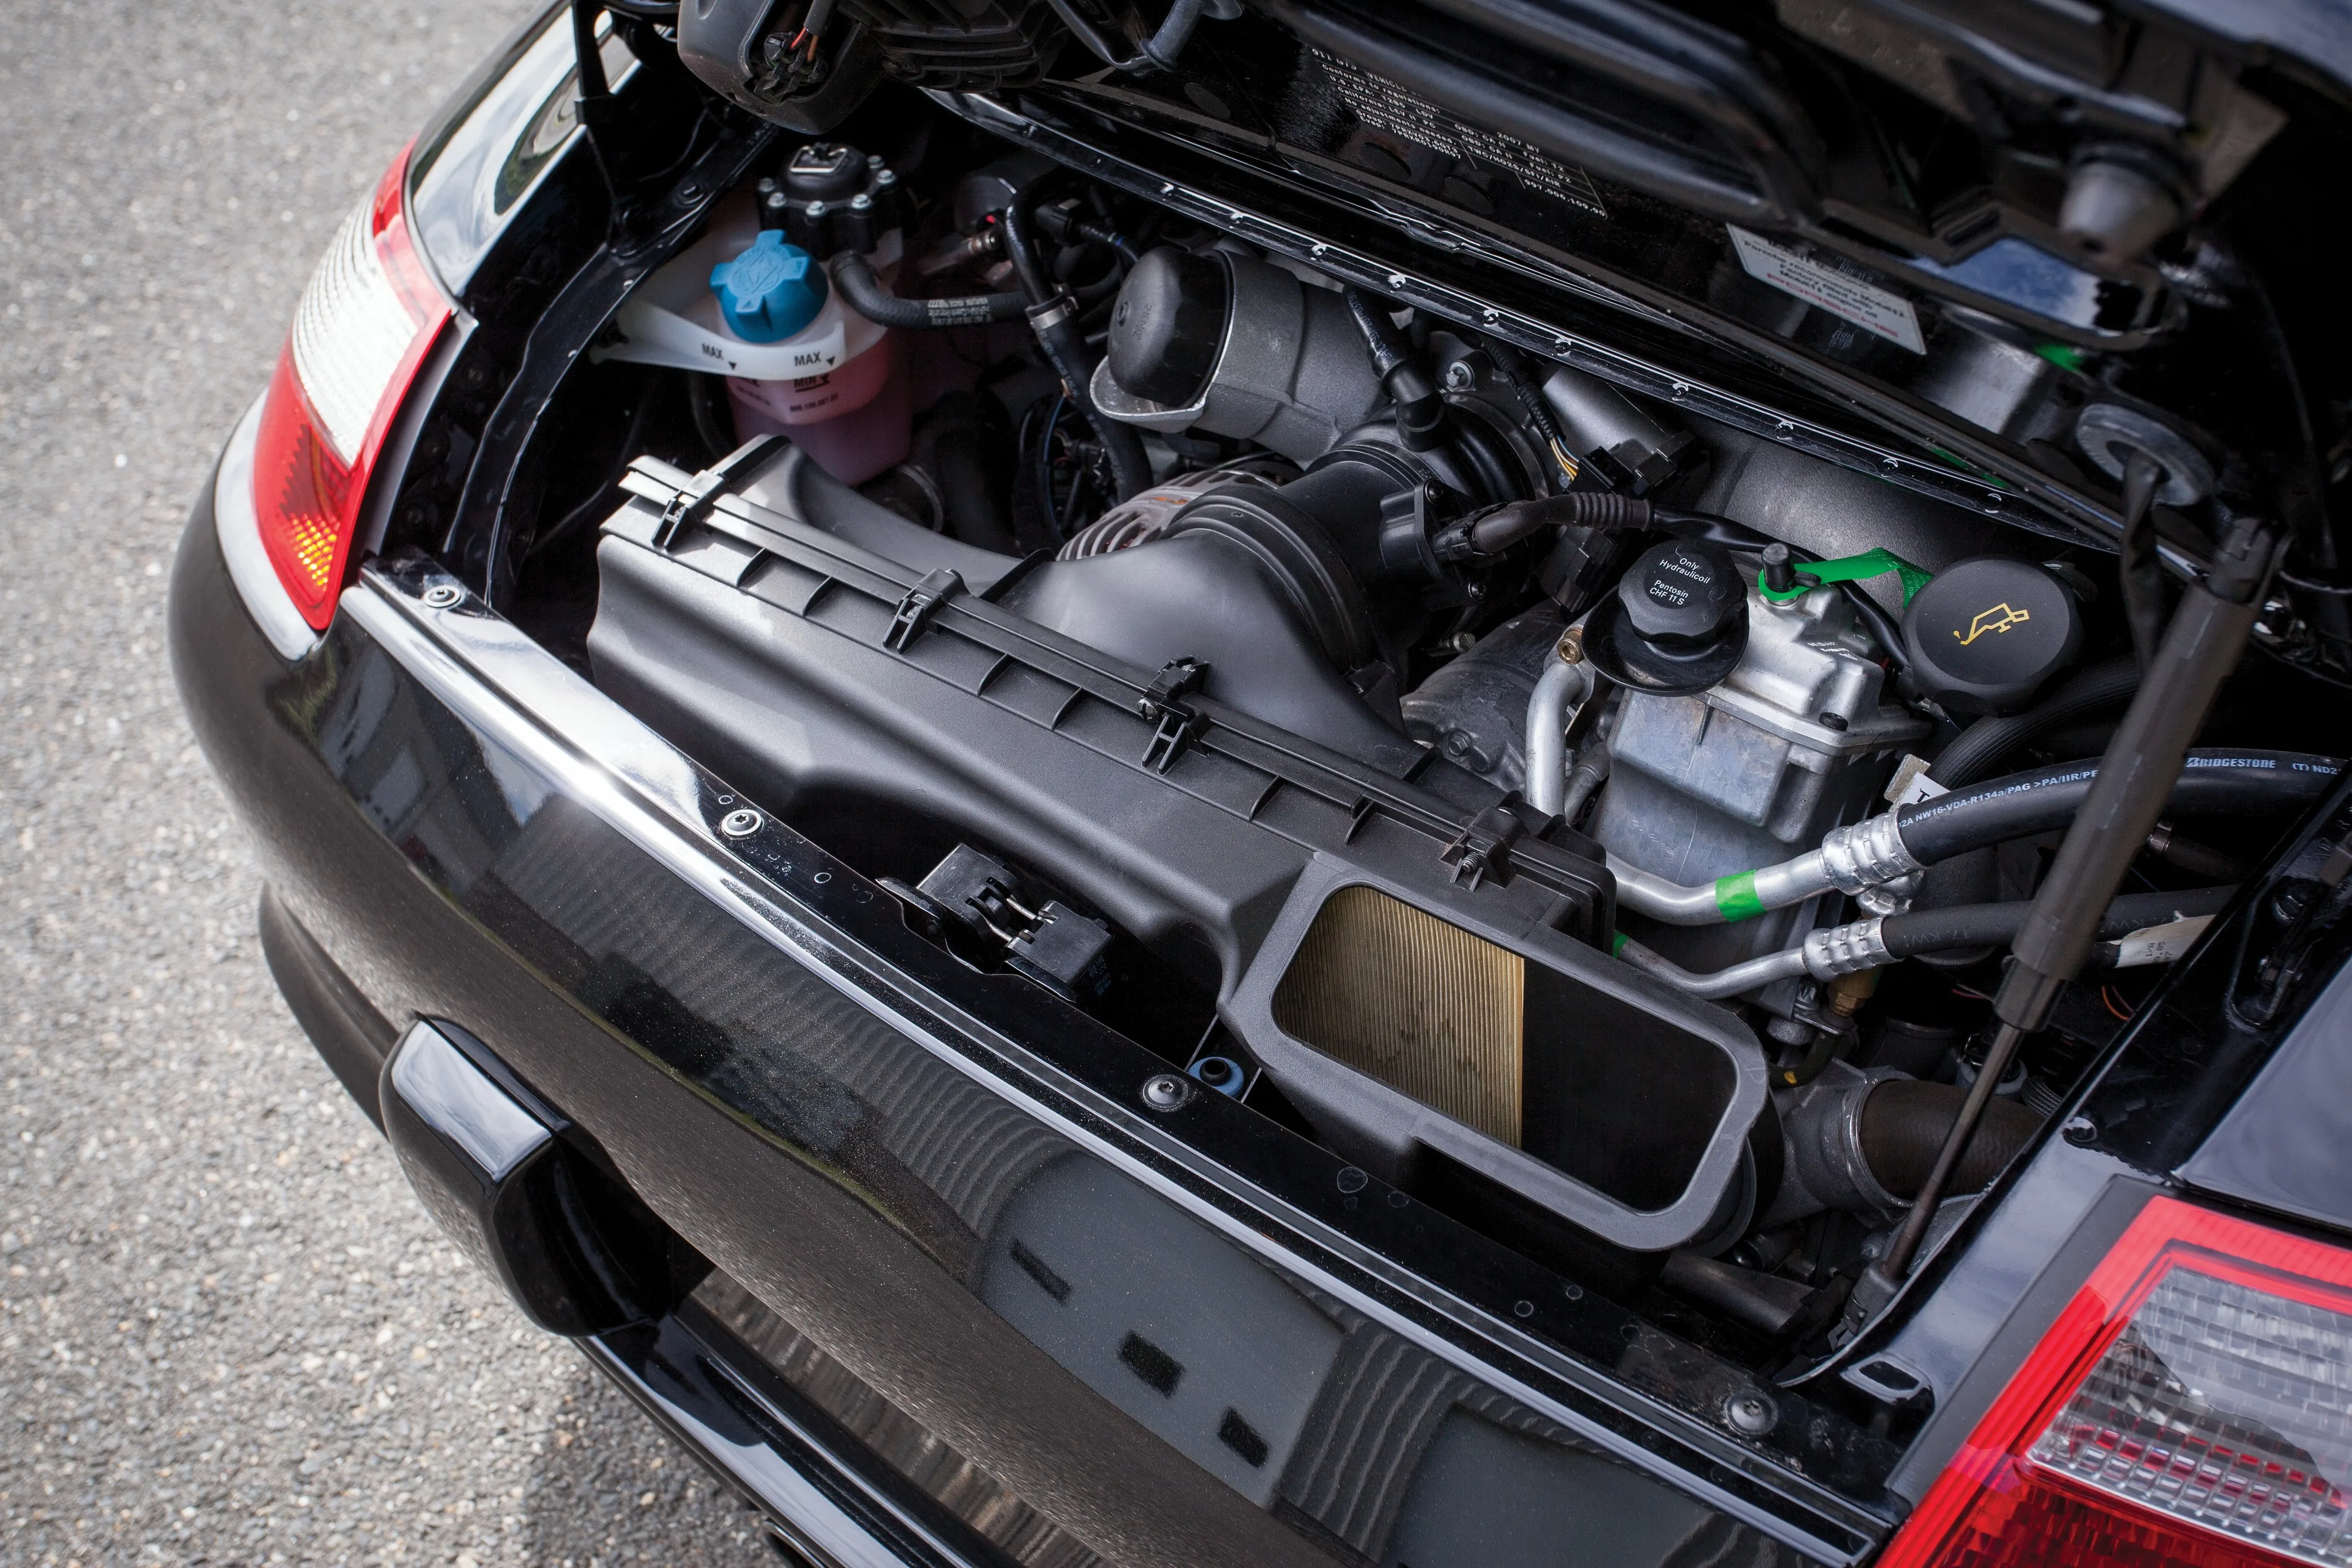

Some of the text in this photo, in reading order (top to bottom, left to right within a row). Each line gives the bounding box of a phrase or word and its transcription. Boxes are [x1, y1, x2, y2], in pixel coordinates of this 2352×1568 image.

[1322, 64, 1365, 84] Conforms
[1383, 88, 1440, 113] regulations:
[1496, 131, 1521, 146] 2007
[1338, 87, 1386, 109] California:
[1345, 98, 1356, 106] No
[1361, 104, 1415, 129] adjustments
[702, 343, 723, 360] MAX
[794, 351, 821, 366] MAX
[1659, 559, 1711, 584] Hydraulicoil
[1680, 557, 1700, 571] Only
[1650, 587, 1668, 598] CHF
[1668, 594, 1677, 602] 11
[1654, 579, 1689, 599] Pentosin
[2185, 757, 2342, 775] BRIDGESTONE (T) ND2
[1898, 817, 1913, 828] 2A
[1915, 783, 2031, 822] NW16-VDA-R134a/PAG
